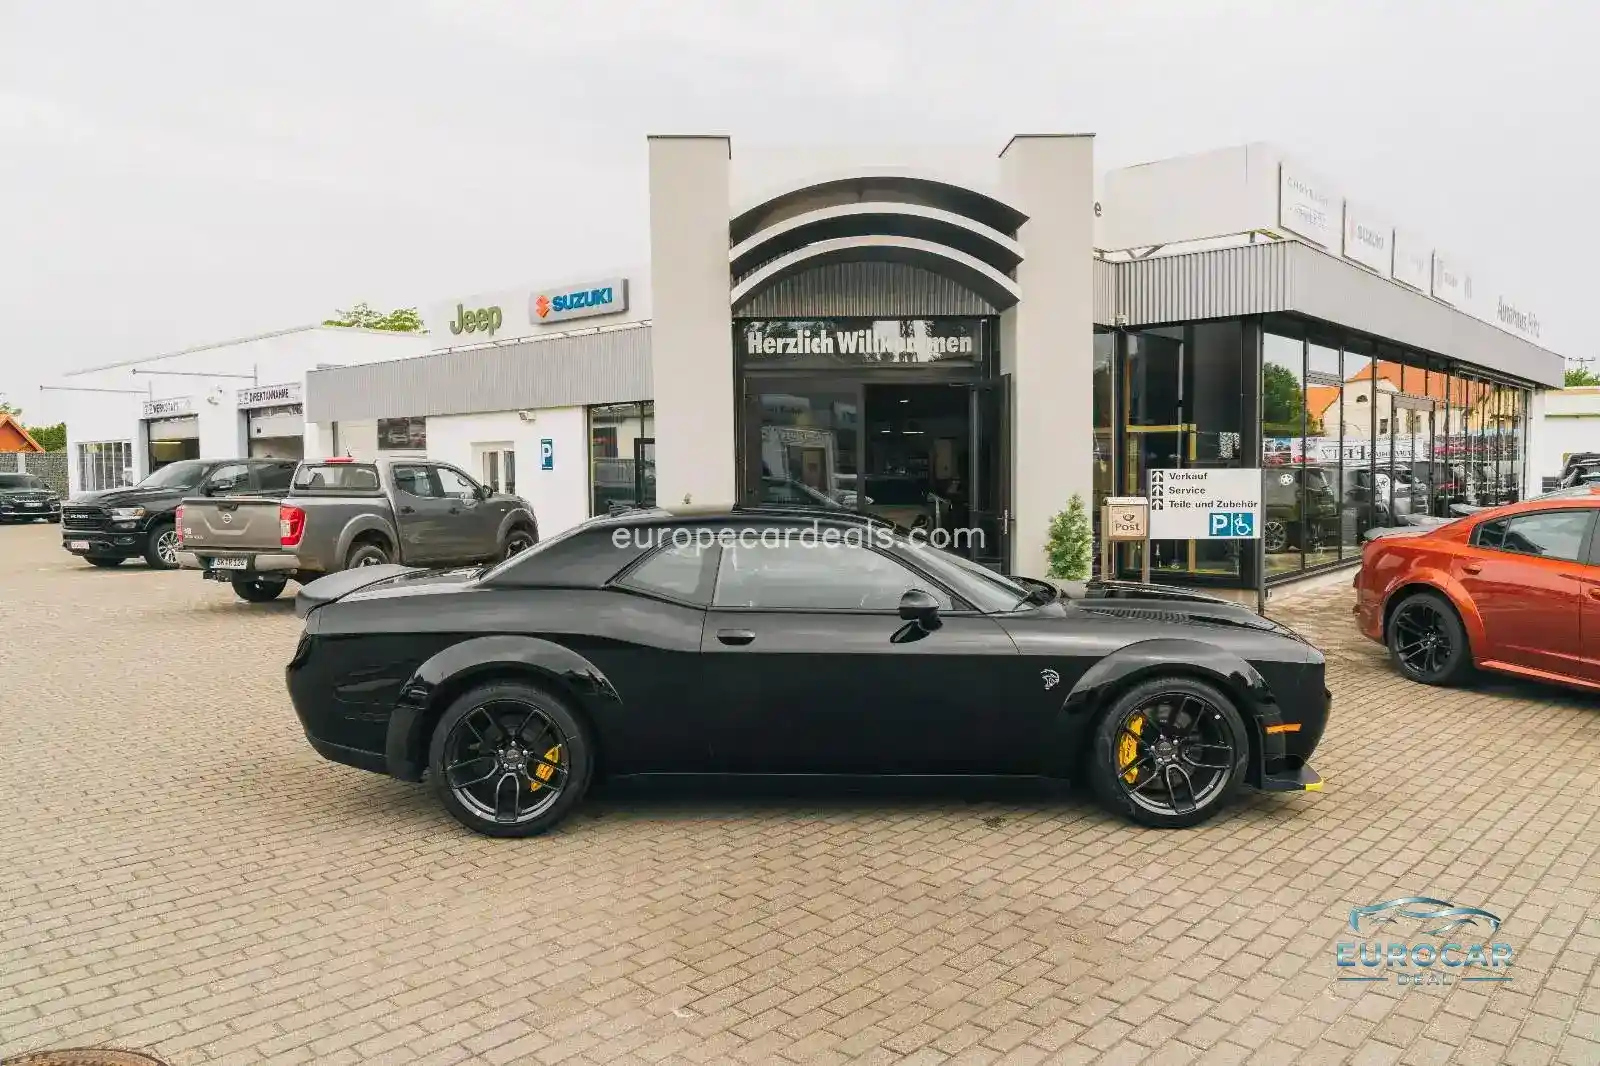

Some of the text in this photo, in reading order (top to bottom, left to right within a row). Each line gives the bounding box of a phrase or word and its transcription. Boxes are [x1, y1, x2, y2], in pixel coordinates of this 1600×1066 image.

[552, 287, 612, 312] SUZUKI
[449, 303, 502, 336] Jeep
[748, 329, 834, 354] Herzlich
[542, 444, 552, 465] P
[1169, 472, 1208, 480] Verkauf
[1169, 486, 1206, 494] Service
[1169, 500, 1258, 508] Teile und Zubehör
[1115, 523, 1140, 531] Post
[1212, 515, 1228, 535] P
